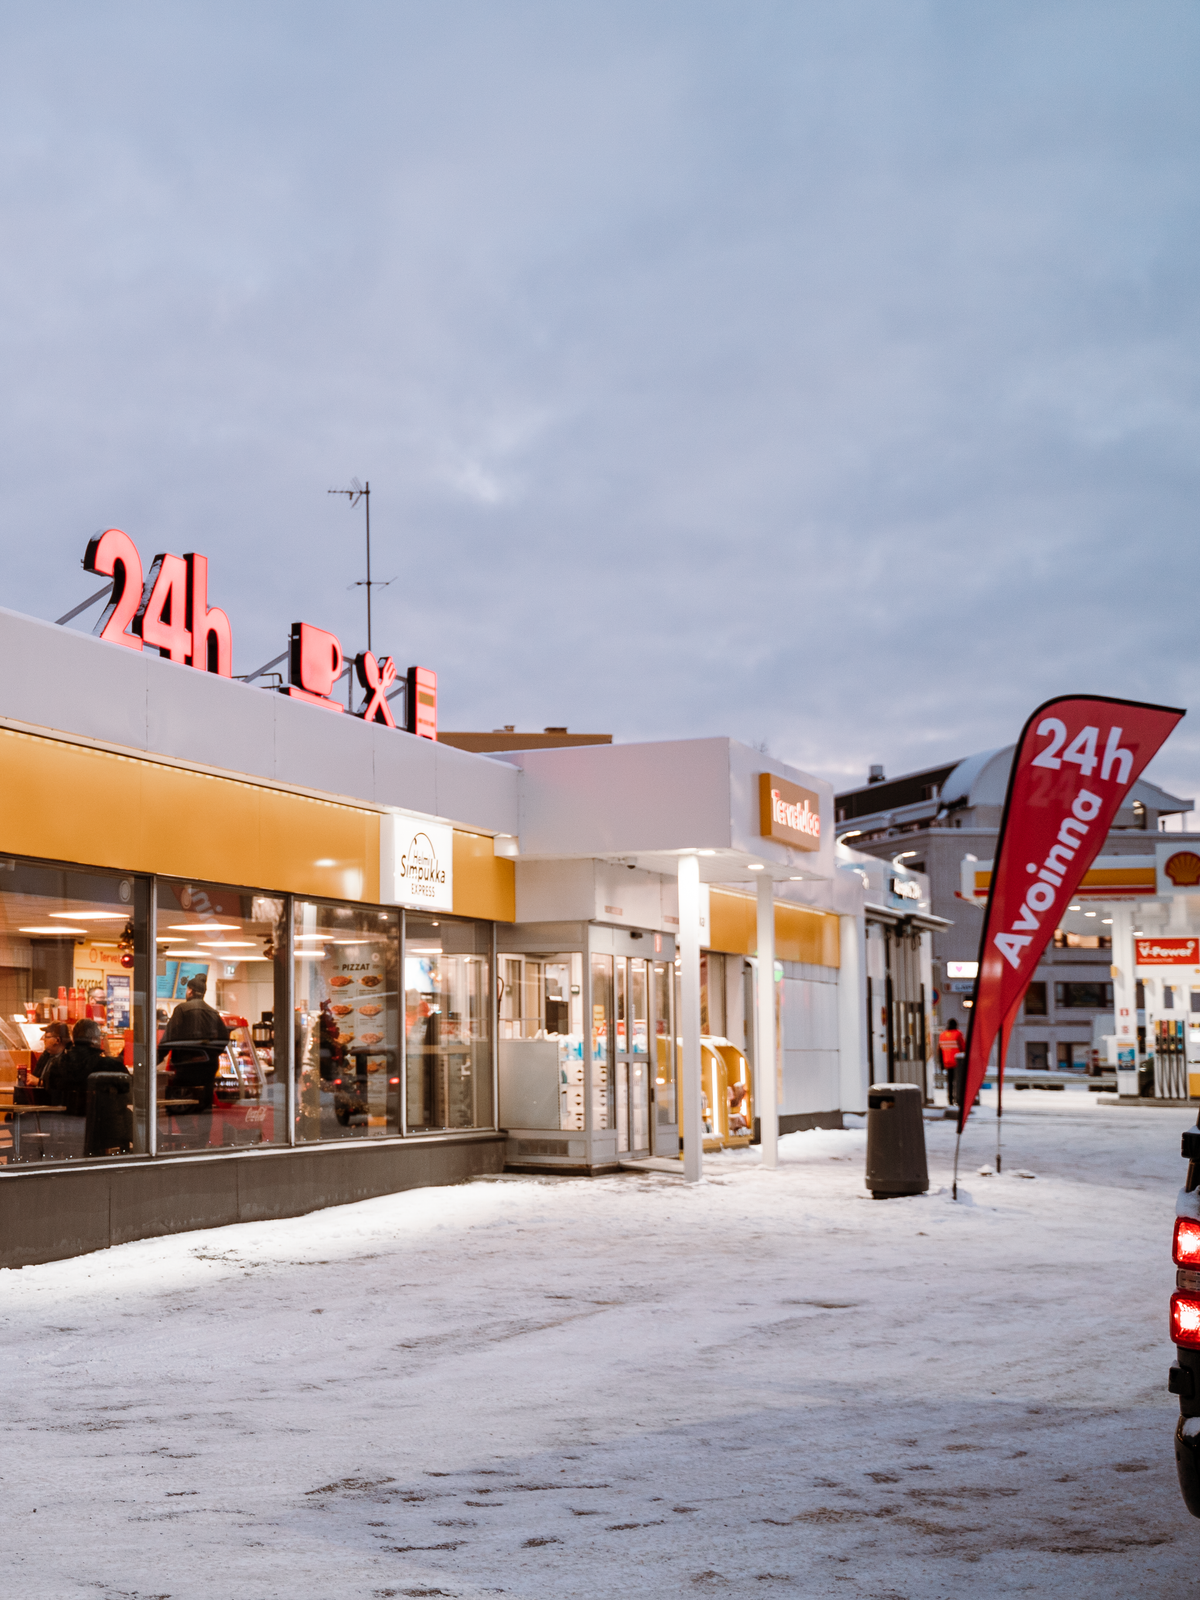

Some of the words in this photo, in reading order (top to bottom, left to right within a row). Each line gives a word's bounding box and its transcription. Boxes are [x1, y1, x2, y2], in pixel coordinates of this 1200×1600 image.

[84, 528, 232, 679] 24h
[1031, 717, 1134, 785] 24h
[771, 788, 821, 838] Tervetuloa
[400, 854, 446, 884] Simpukka
[412, 849, 431, 867] Helmi
[411, 882, 435, 898] EXPRESS
[993, 788, 1103, 970] Avoinna
[1138, 945, 1194, 958] V-Power
[341, 962, 371, 972] PIZZAT
